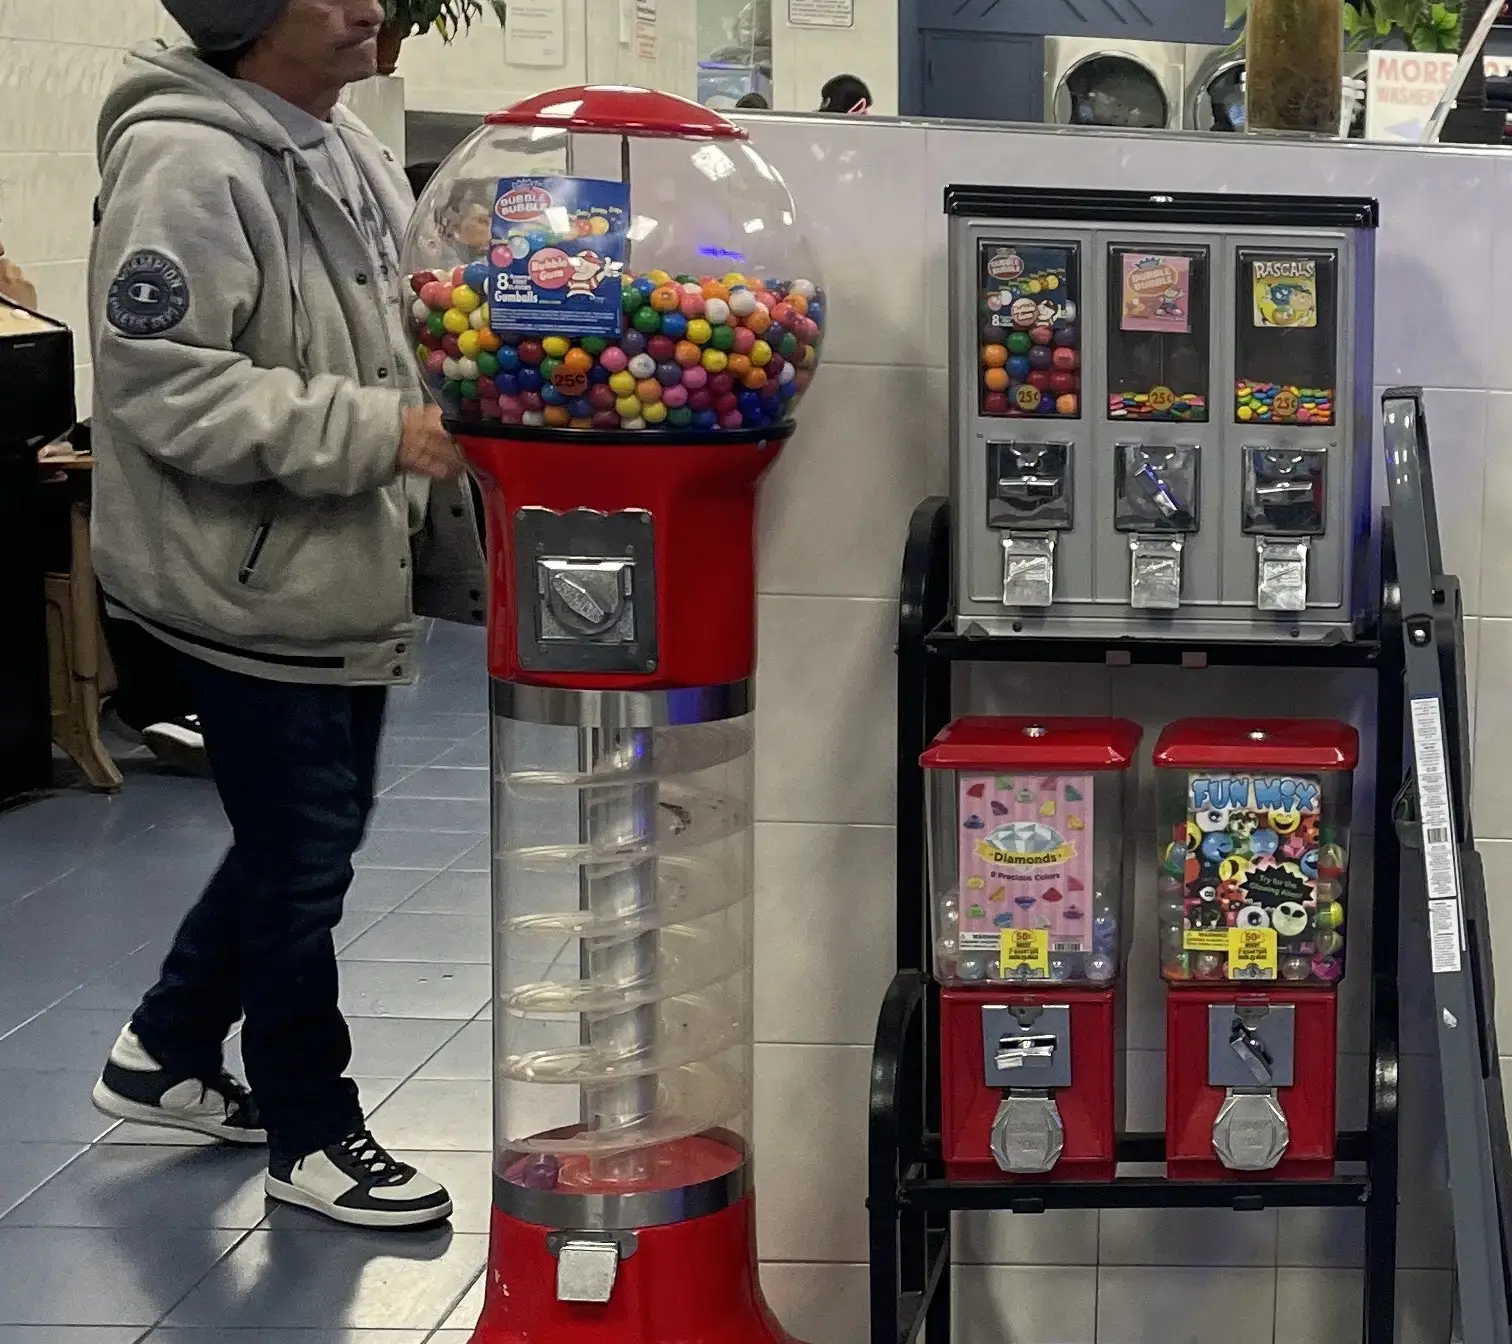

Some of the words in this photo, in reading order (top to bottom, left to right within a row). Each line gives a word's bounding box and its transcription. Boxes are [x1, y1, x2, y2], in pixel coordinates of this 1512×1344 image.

[531, 258, 568, 272] Bubble
[1253, 262, 1316, 279] RASCALS
[497, 273, 508, 290] 8
[539, 269, 564, 281] Gum
[494, 290, 538, 303] Gumballs
[1192, 778, 1249, 810] FUN
[993, 851, 1057, 865] Diamonds
[997, 871, 1033, 882] Precious
[1034, 872, 1060, 882] Colors
[1259, 875, 1272, 886] Try
[1272, 877, 1283, 886] for
[1284, 880, 1298, 890] the
